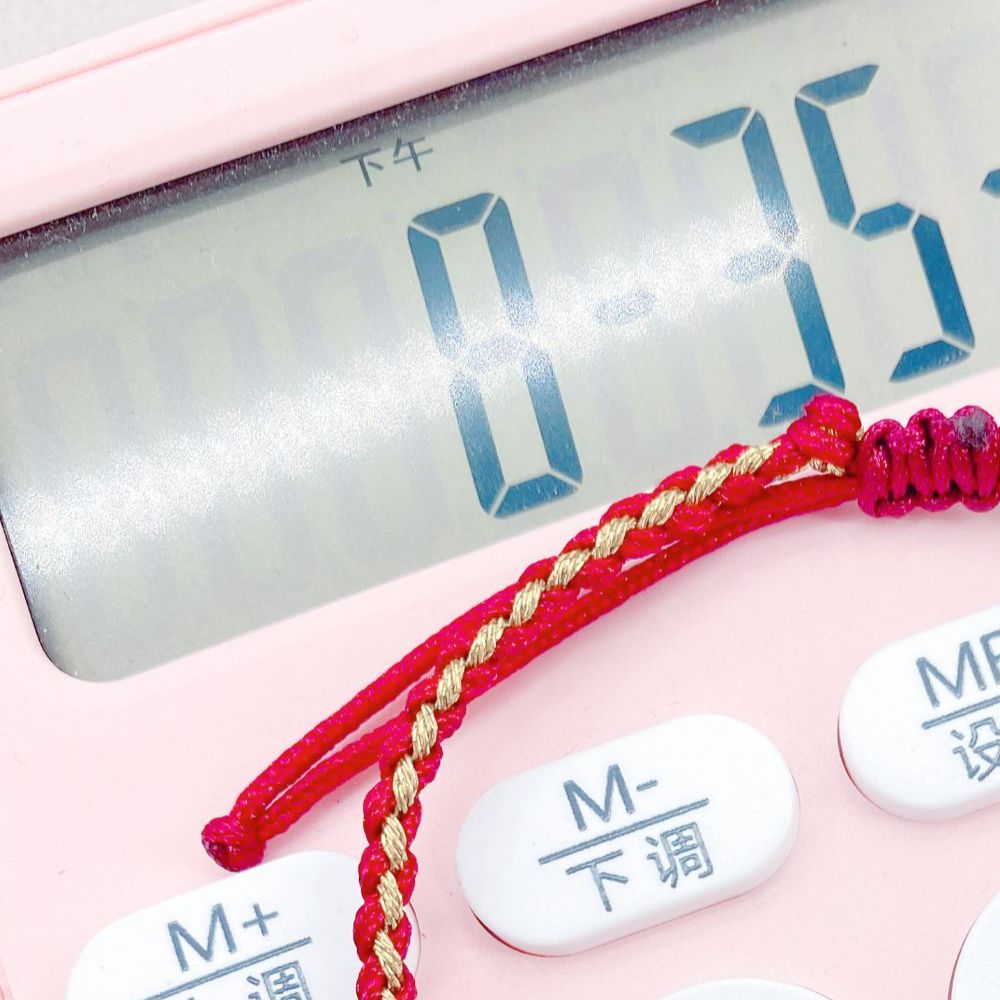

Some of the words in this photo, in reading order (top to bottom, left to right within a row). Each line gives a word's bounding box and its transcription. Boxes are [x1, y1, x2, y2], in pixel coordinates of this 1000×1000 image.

[340, 136, 434, 187] 下午
[563, 764, 659, 831] M-
[565, 821, 714, 912] 下调
[166, 902, 278, 973] M+
